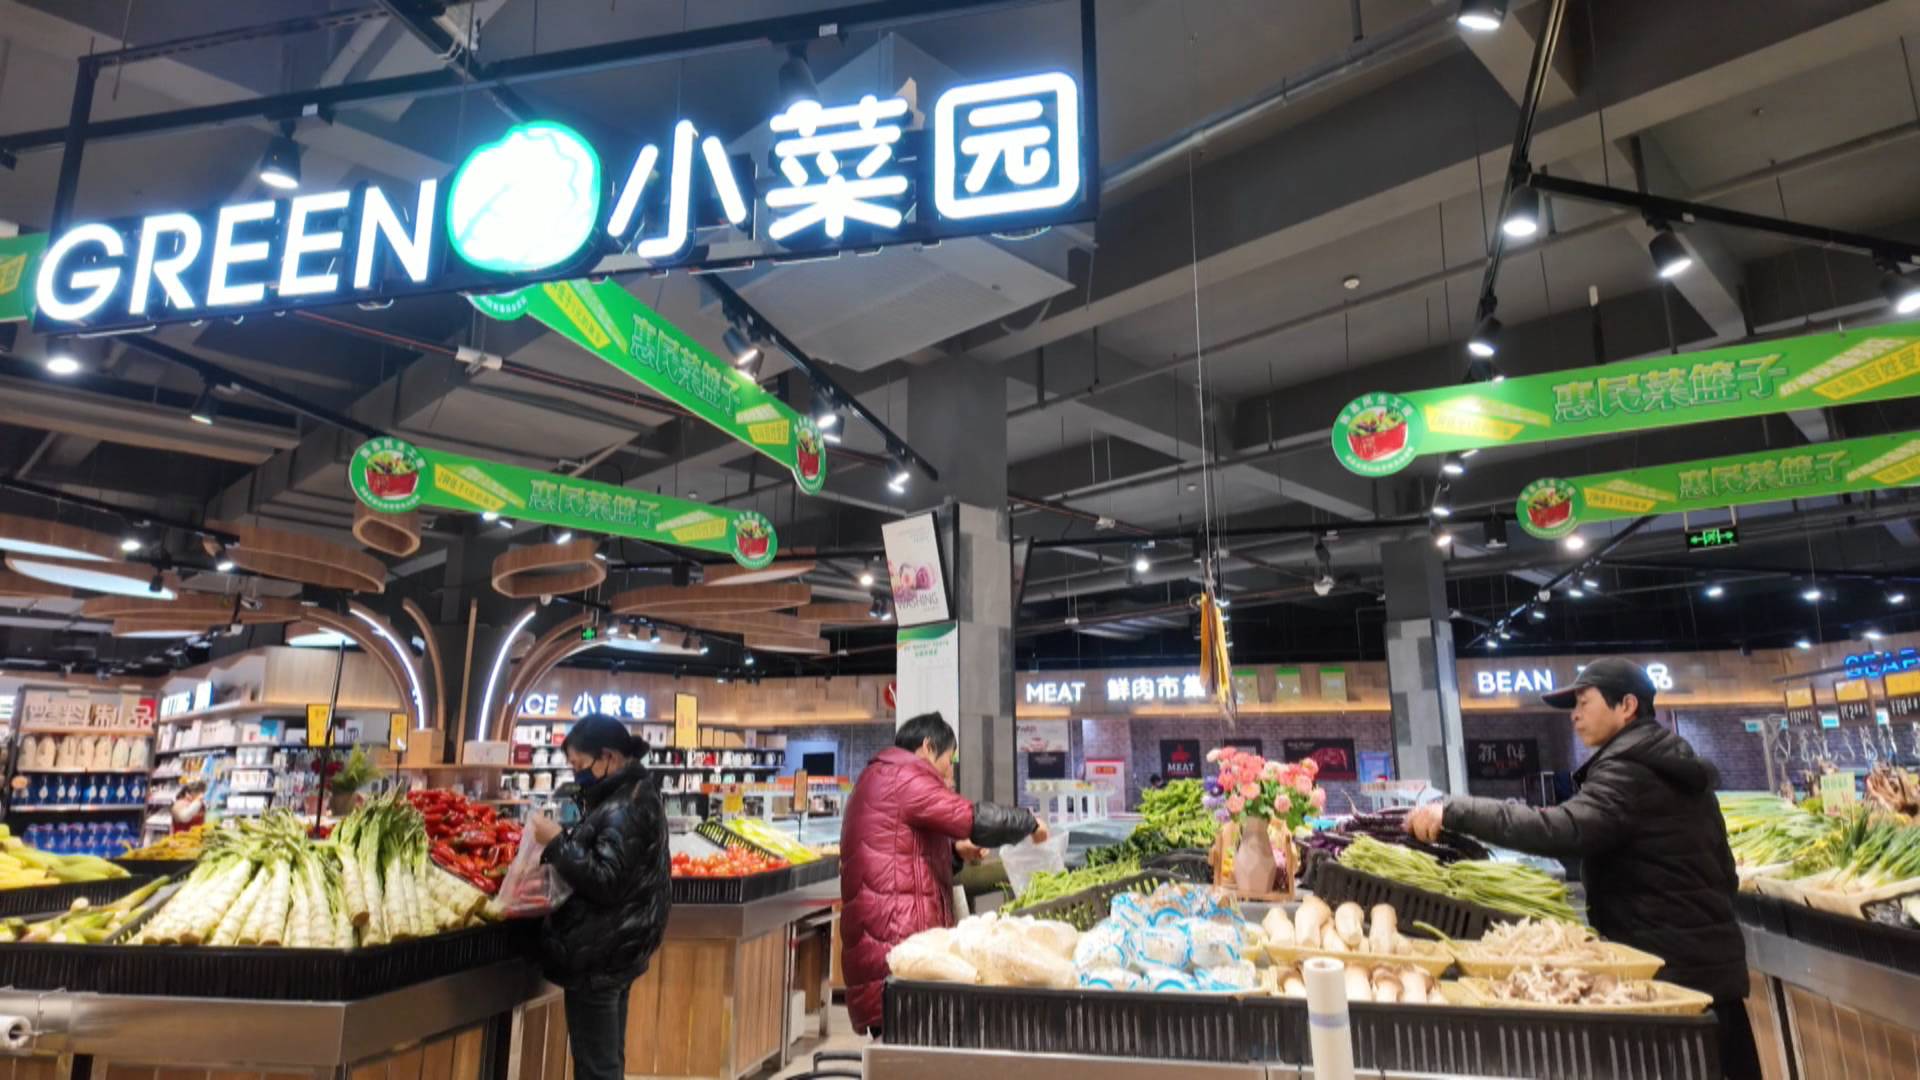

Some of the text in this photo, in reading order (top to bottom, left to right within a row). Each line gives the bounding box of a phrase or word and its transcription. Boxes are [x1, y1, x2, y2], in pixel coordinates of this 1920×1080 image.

[36, 179, 438, 322] GREEN
[607, 71, 1080, 258] 小菜园
[631, 313, 741, 417] 惠民菜篮子
[1552, 352, 1788, 424] 惠民菜篮子
[1679, 450, 1851, 500] 惠民菜篮子
[528, 478, 661, 530] 惠民菜篮子
[572, 691, 647, 718] 小家电
[1025, 681, 1085, 703] MEAT
[1477, 669, 1553, 694] BEAN
[1167, 762, 1194, 772] MEAT
